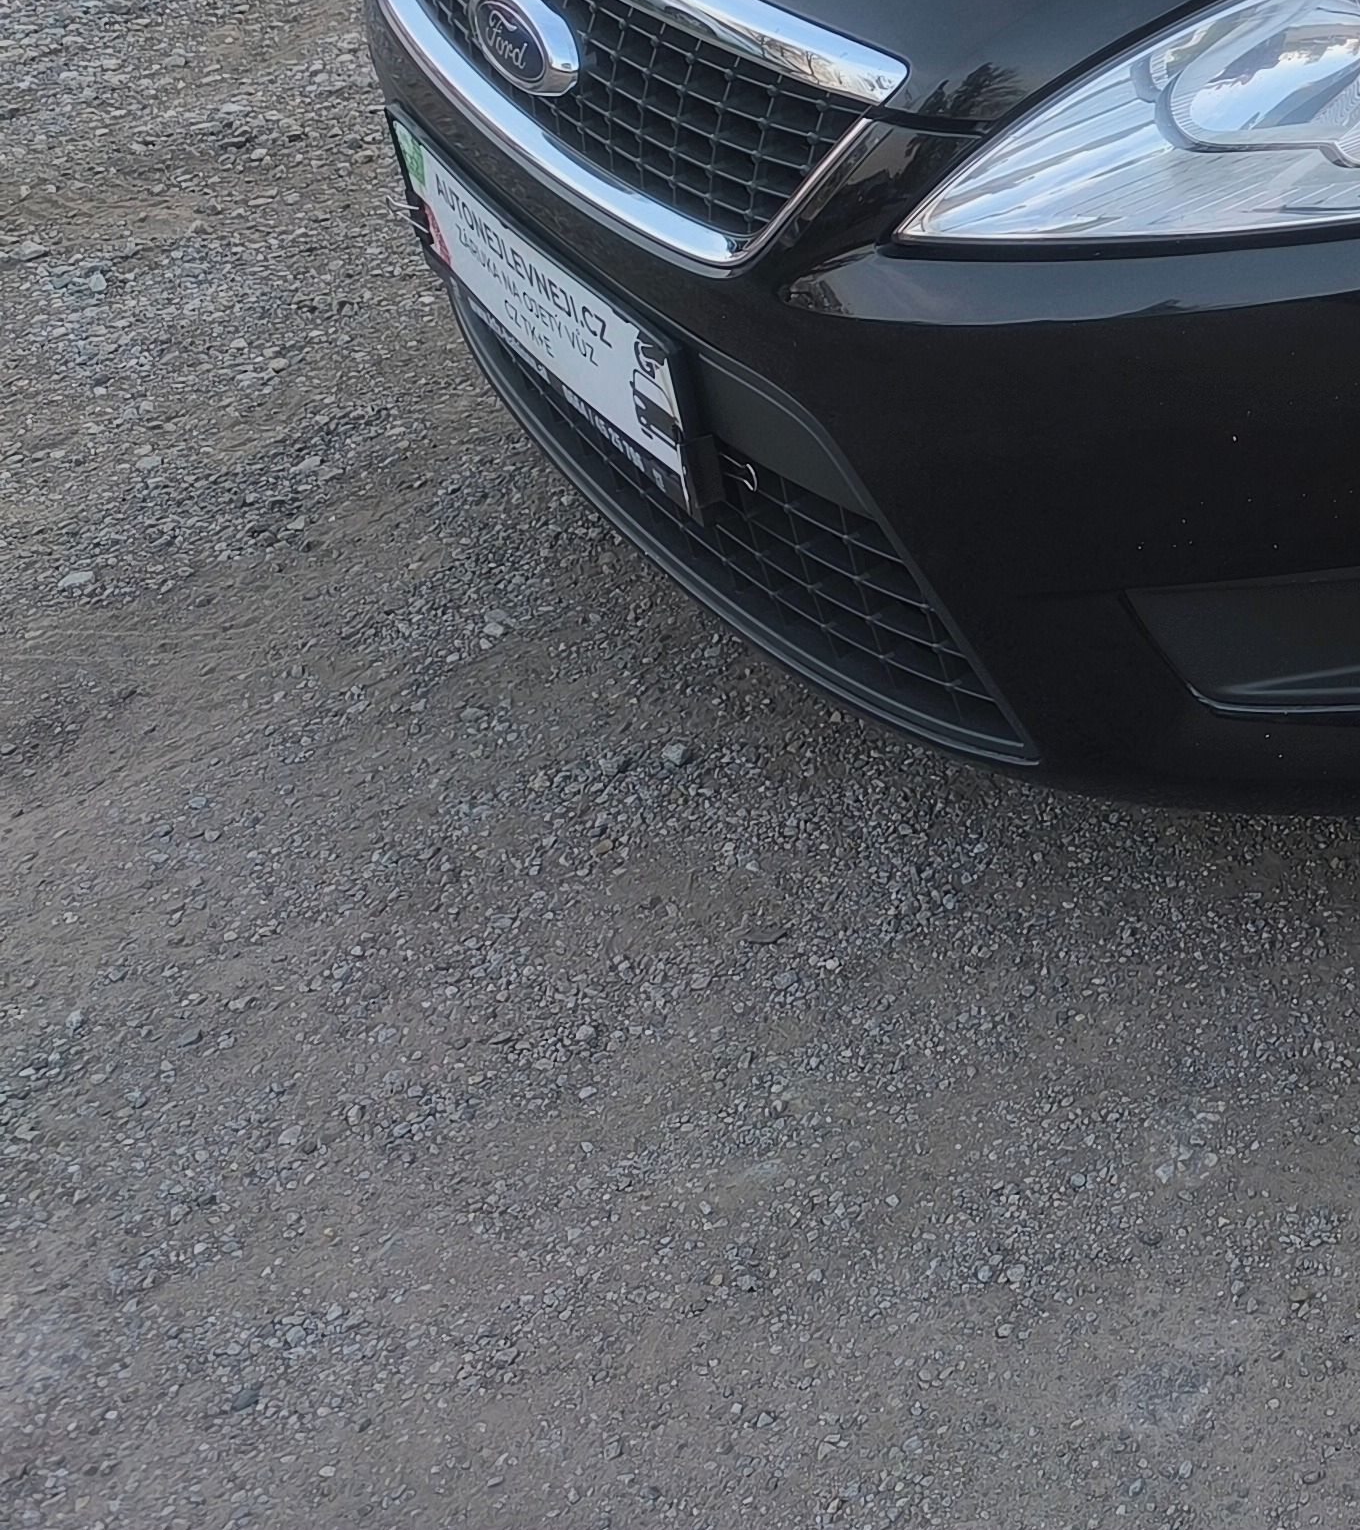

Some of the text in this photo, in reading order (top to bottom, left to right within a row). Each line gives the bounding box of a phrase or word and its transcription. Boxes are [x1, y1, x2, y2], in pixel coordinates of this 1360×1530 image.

[486, 10, 528, 69] Ford
[435, 173, 613, 348] AUTONEJLEVNEJI.CZ
[502, 272, 521, 303] NA
[523, 291, 563, 338] OJETÝ
[564, 324, 599, 367] VŮZ
[504, 299, 522, 329] CZ
